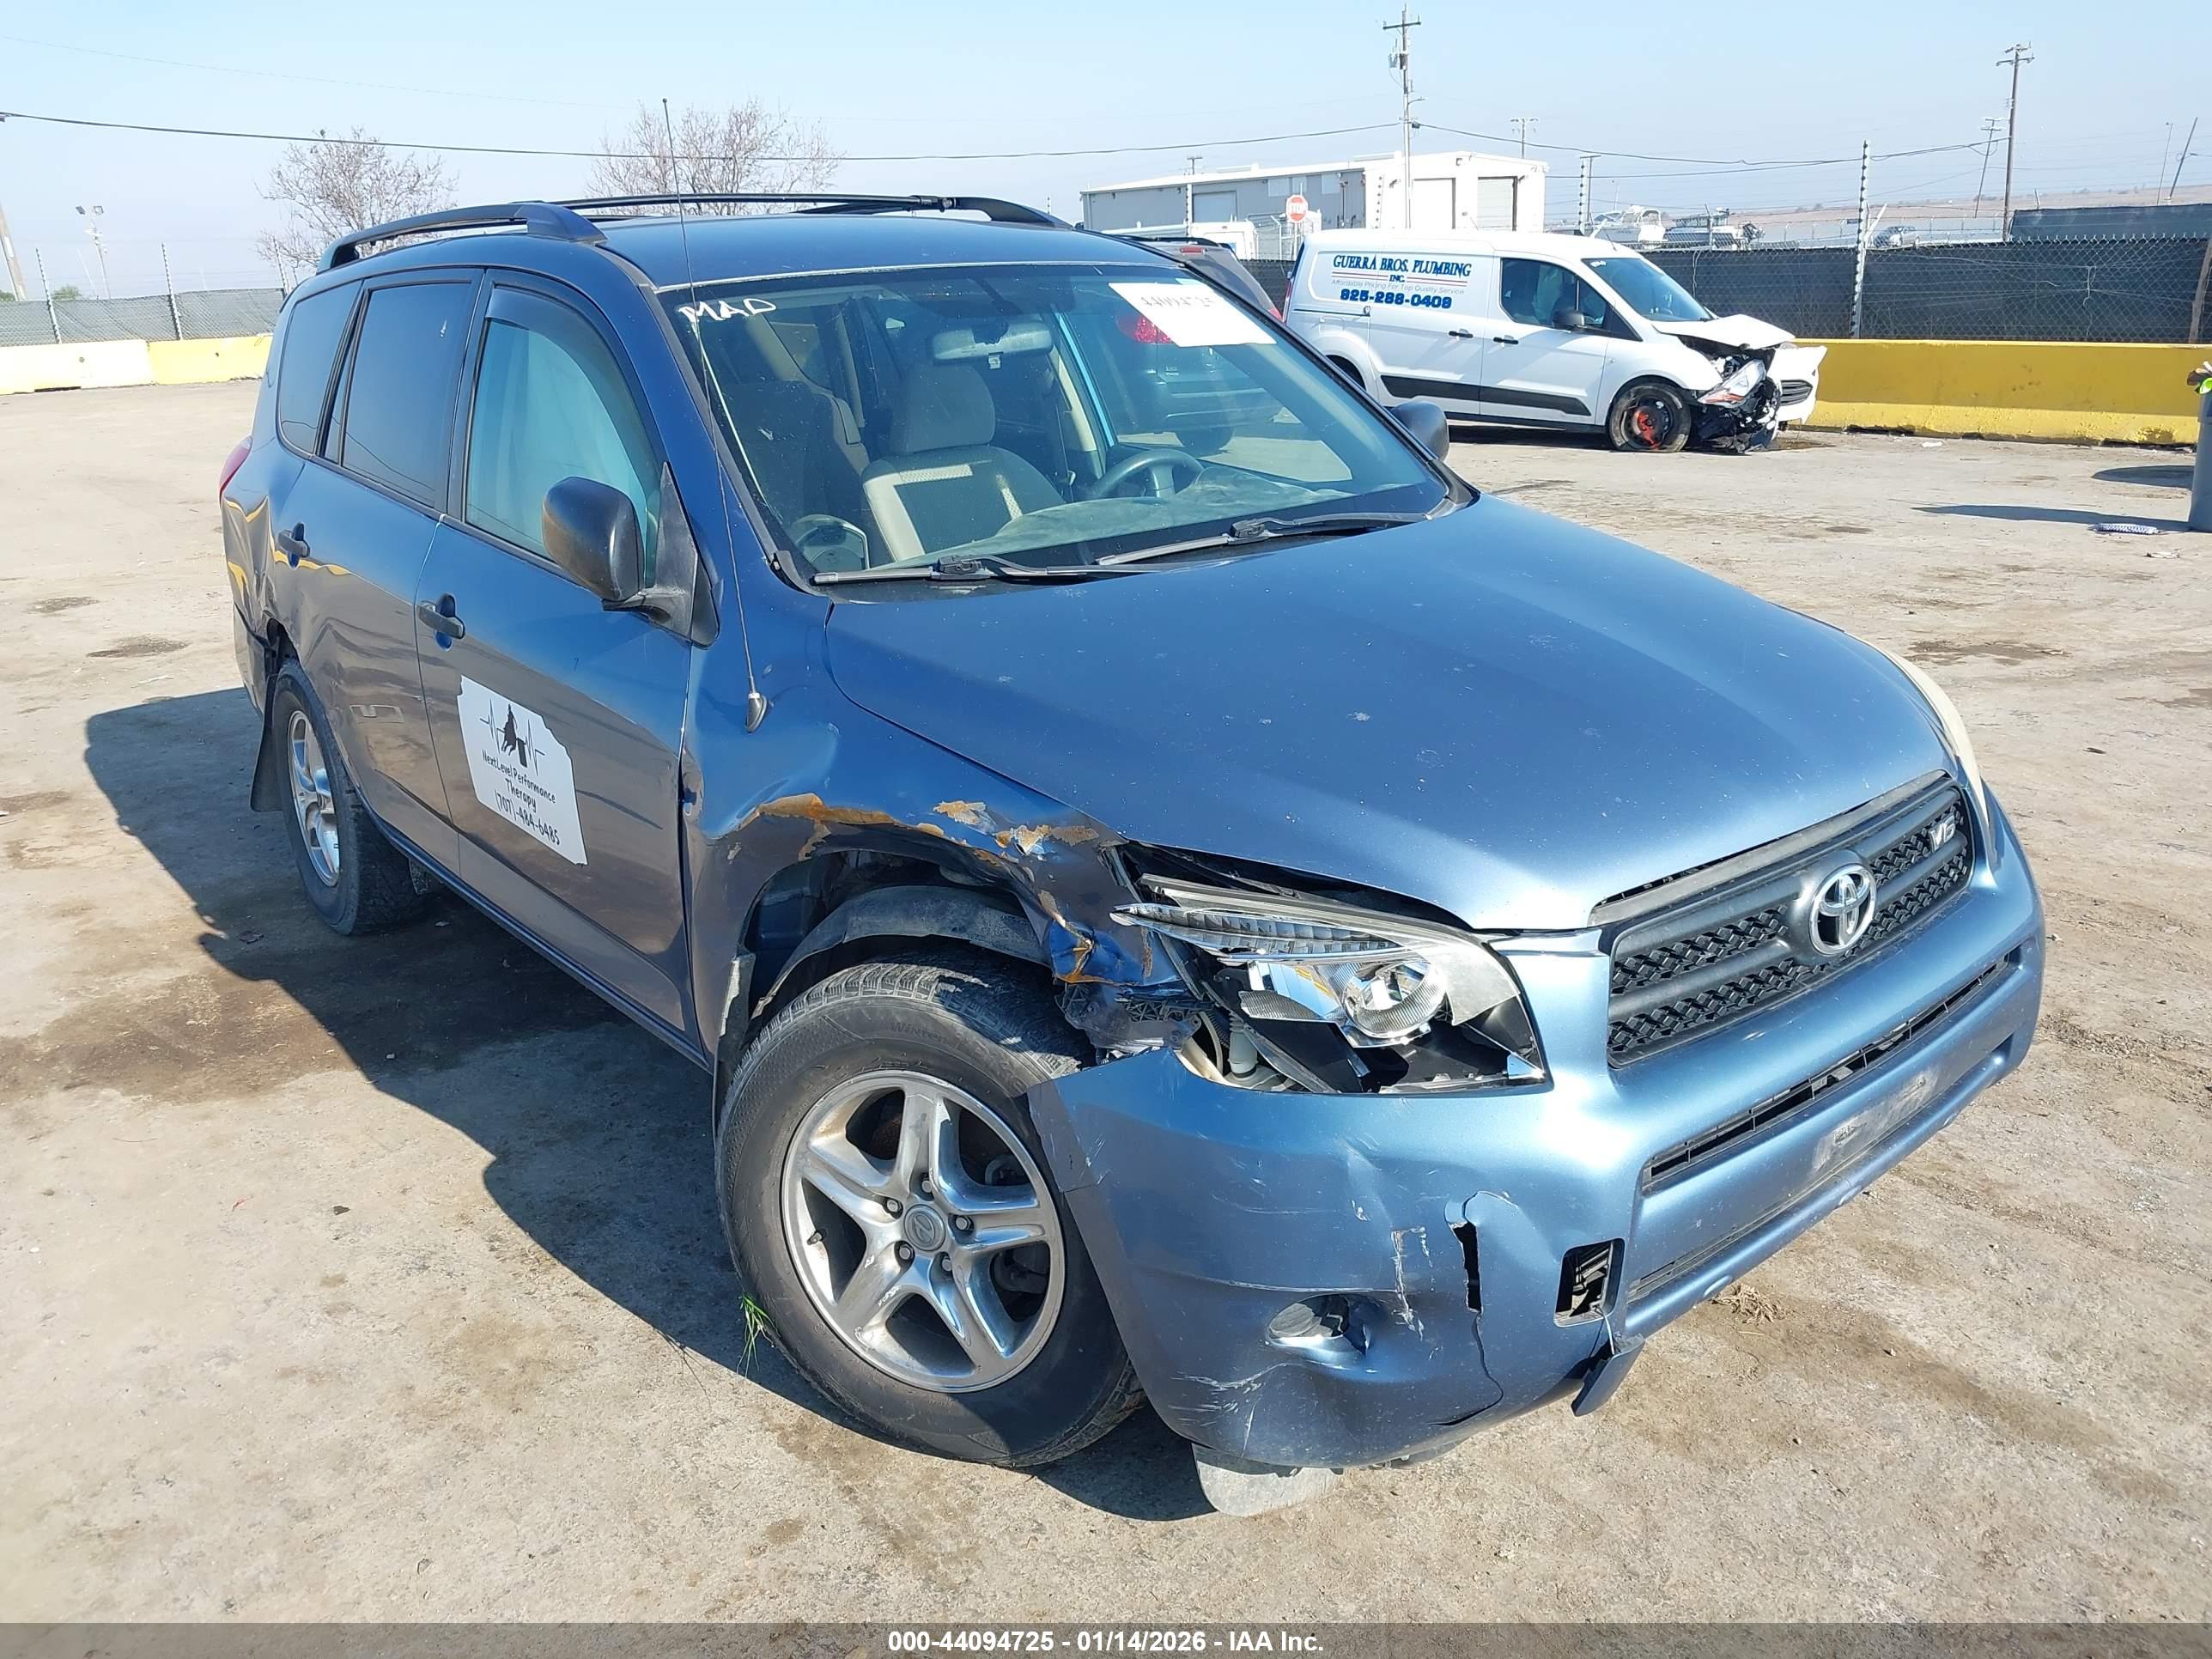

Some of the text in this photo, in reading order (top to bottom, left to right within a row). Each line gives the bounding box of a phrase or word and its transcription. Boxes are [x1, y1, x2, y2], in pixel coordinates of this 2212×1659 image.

[1333, 254, 1472, 276] GUERRA BROS. PLUMBING
[1389, 274, 1405, 283] INC.
[678, 298, 777, 324] MAD
[505, 778, 537, 813] Therapy
[513, 766, 556, 804] Performance
[1929, 814, 1956, 852] V6
